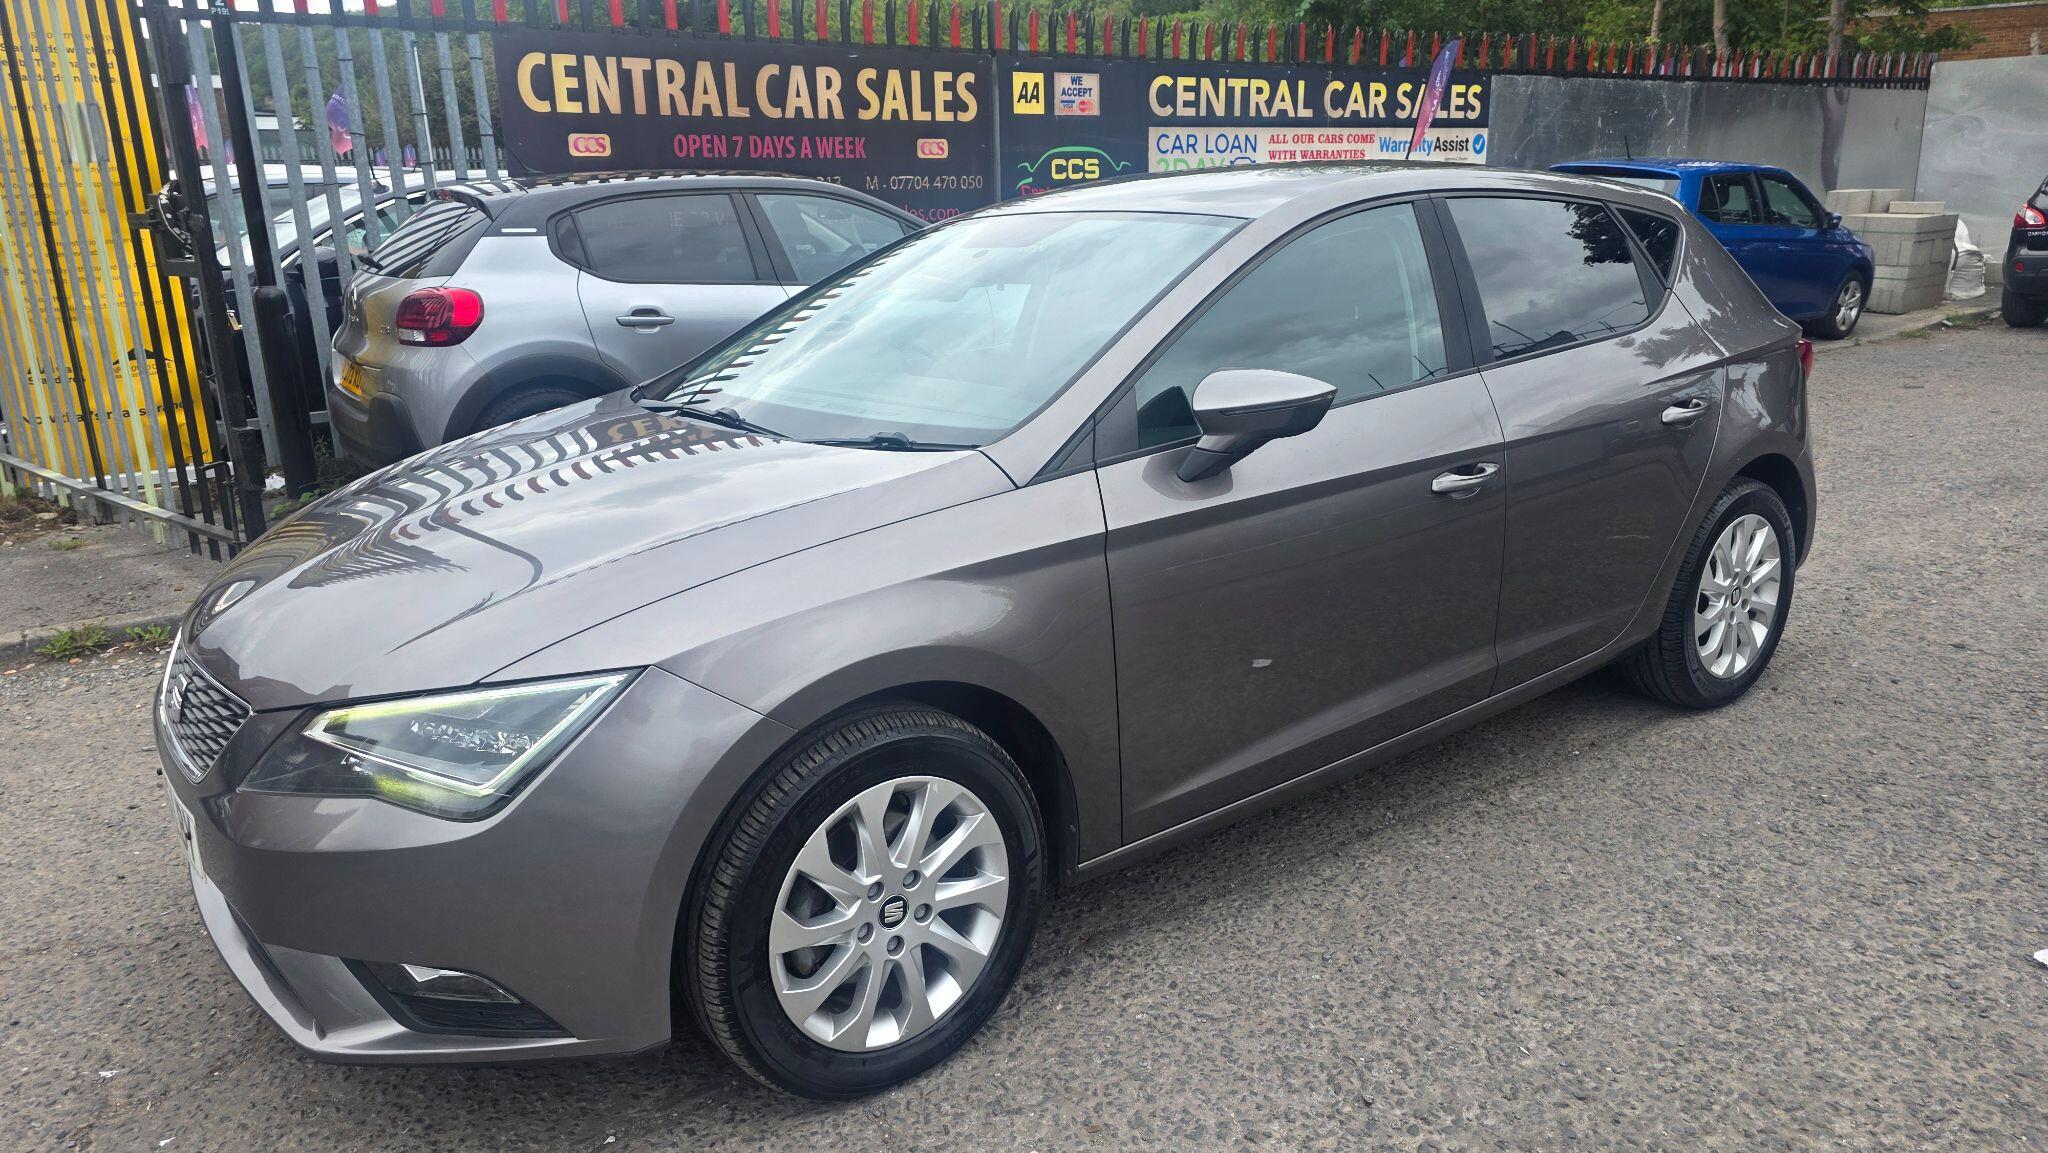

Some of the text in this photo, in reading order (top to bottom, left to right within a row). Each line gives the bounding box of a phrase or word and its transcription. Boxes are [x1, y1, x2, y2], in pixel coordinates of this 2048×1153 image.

[517, 51, 978, 122] CENTRAL CAR SALES
[1070, 75, 1084, 86] WE
[1016, 81, 1040, 104] AA
[1060, 87, 1093, 98] ACCEPT
[1148, 75, 1314, 118] CENTRAL
[1324, 80, 1387, 119] CAR
[573, 136, 607, 154] CCS
[673, 133, 867, 159] OPEN 7 DAYS A WEEK
[1156, 133, 1258, 154] CAR LOAN
[1268, 133, 1376, 144] ALL OUR CARS COME
[1379, 135, 1470, 156] WarrtyAssist
[920, 141, 946, 156] CCS
[1268, 148, 1366, 160] WITH WARRANTIES
[1051, 158, 1100, 180] CCS
[890, 175, 930, 190] 07704
[933, 175, 957, 190] 470
[960, 175, 983, 190] 050
